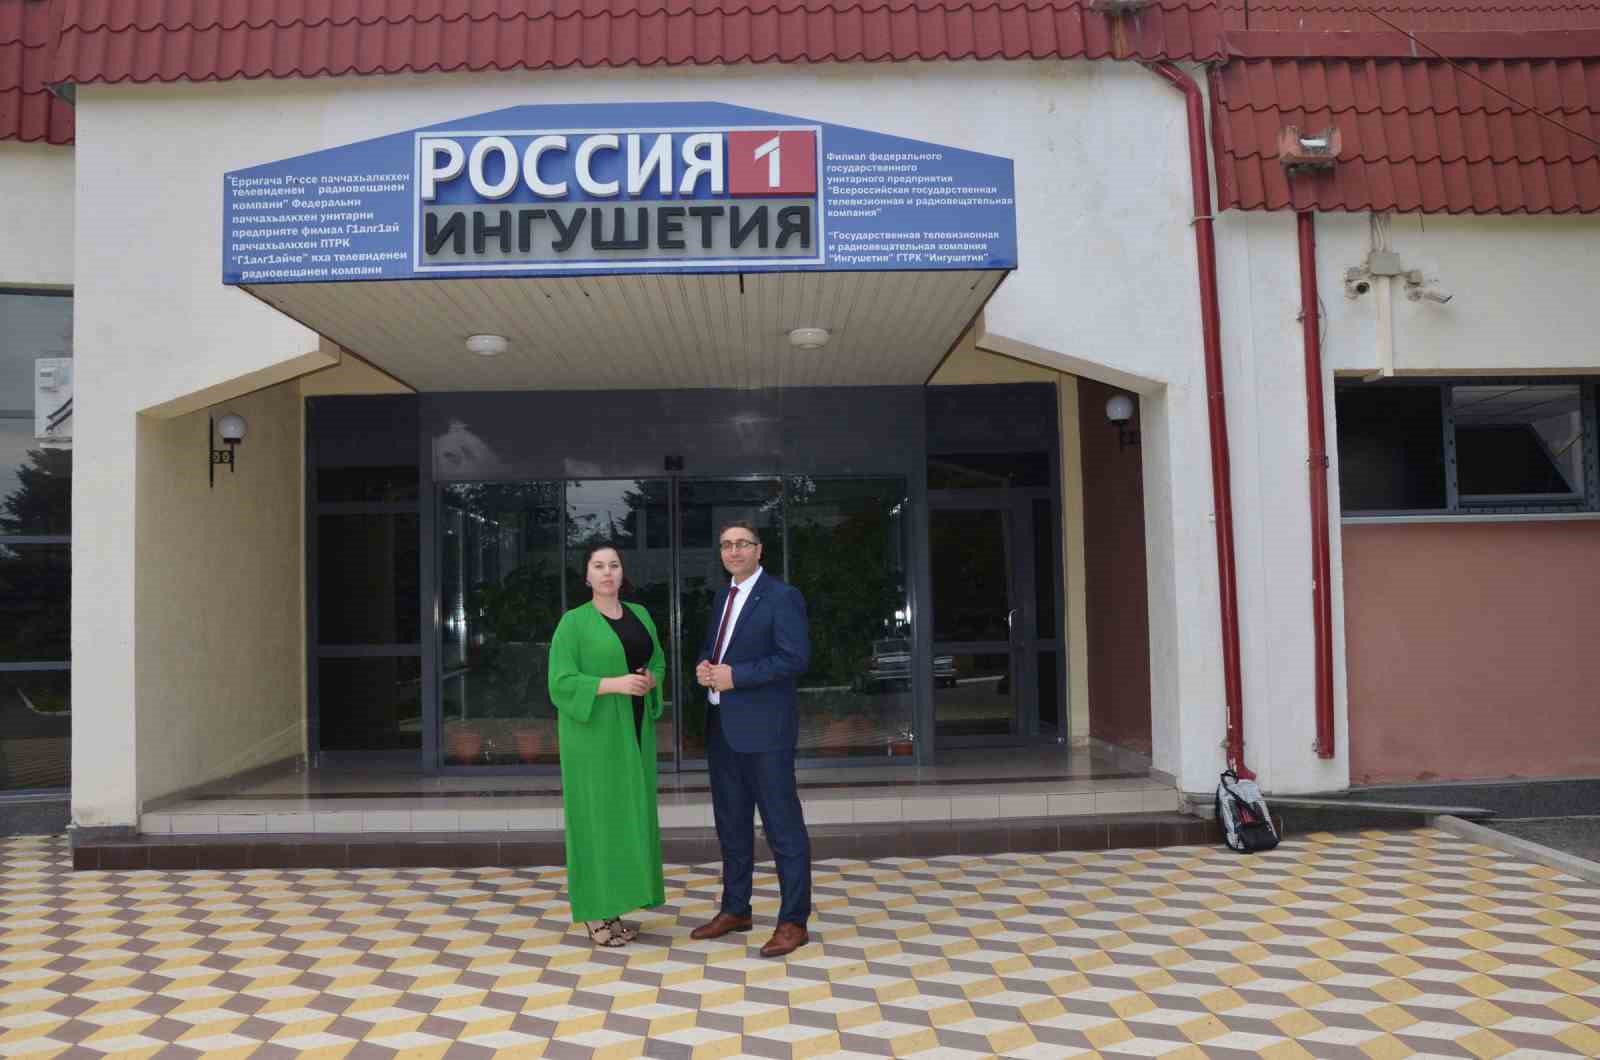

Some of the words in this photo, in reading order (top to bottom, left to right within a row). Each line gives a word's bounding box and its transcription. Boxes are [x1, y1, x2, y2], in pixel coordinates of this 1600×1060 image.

[826, 152, 866, 161] Филиал
[869, 151, 943, 162] федерального
[421, 133, 724, 201] РОССИЯ
[753, 135, 781, 188] 1
[826, 164, 918, 174] государственного
[826, 175, 885, 184] унитарного
[888, 175, 953, 184] предприятия
[912, 186, 997, 196] государственная
[827, 198, 905, 206] телевизионная
[915, 197, 1013, 207] радиовещательная
[321, 211, 374, 223] унитарни
[301, 225, 343, 237] филиал
[425, 204, 811, 256] ИНГУШЕТИЯ
[923, 230, 1000, 239] телевизионная
[838, 243, 936, 252] радиовещательная
[938, 242, 987, 250] компания
[896, 253, 922, 263] ГТРК
